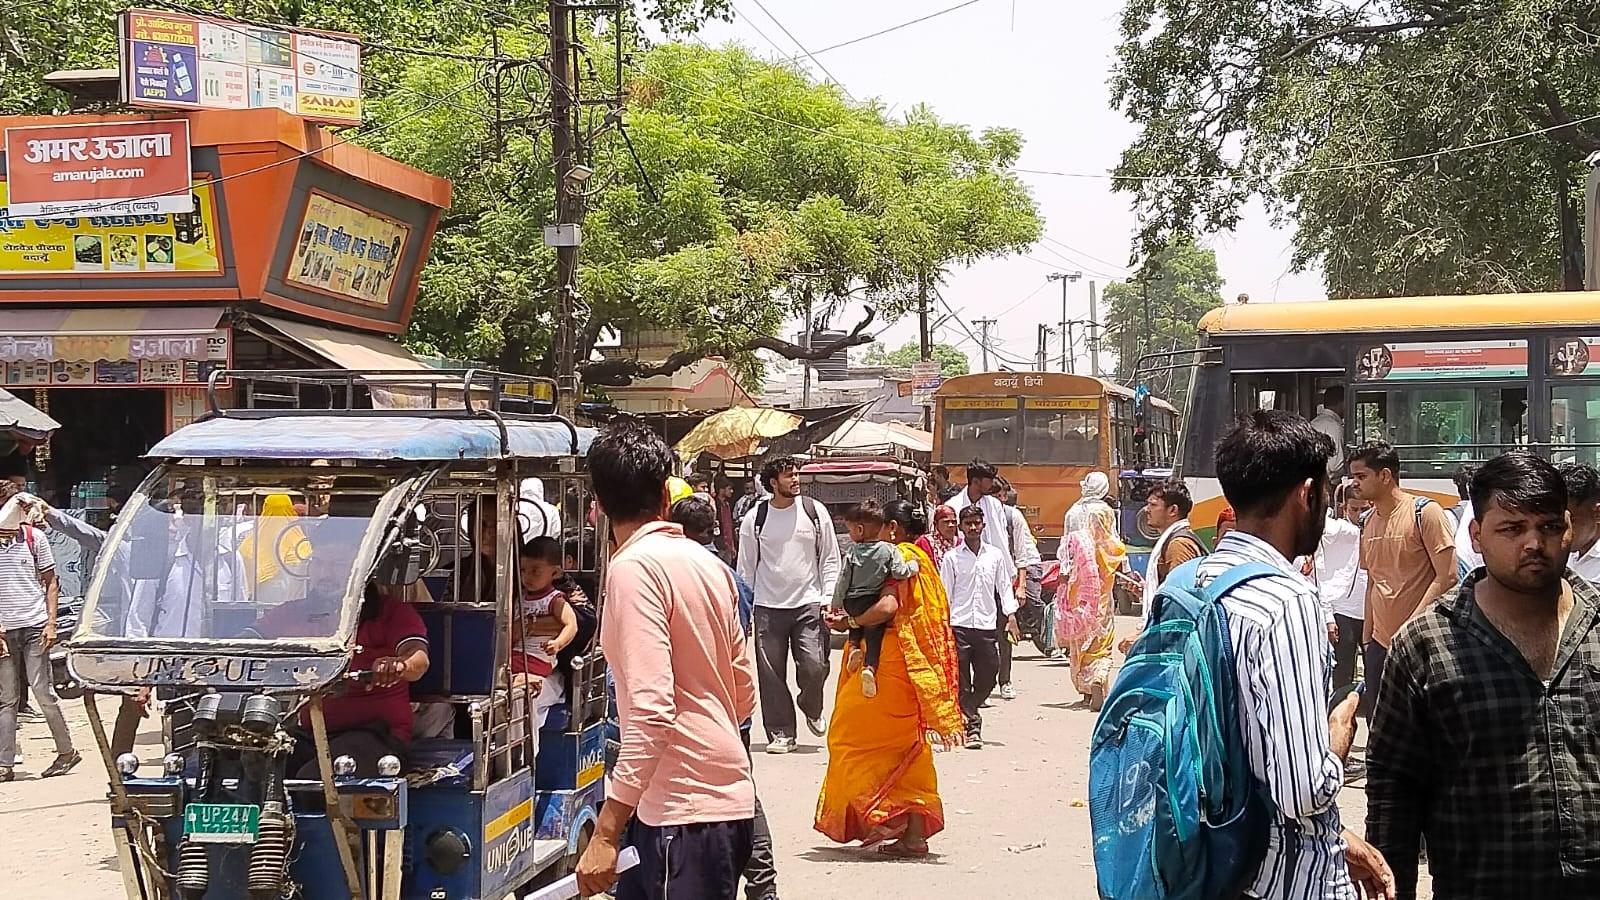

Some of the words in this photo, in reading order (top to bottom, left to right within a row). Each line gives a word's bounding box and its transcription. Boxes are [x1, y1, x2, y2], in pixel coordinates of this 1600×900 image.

[302, 95, 356, 109] SAHAJ
[24, 138, 88, 164] अमर
[88, 133, 172, 160] उजाला
[53, 167, 144, 183] amarujala.com
[994, 374, 1020, 389] बदायूँ
